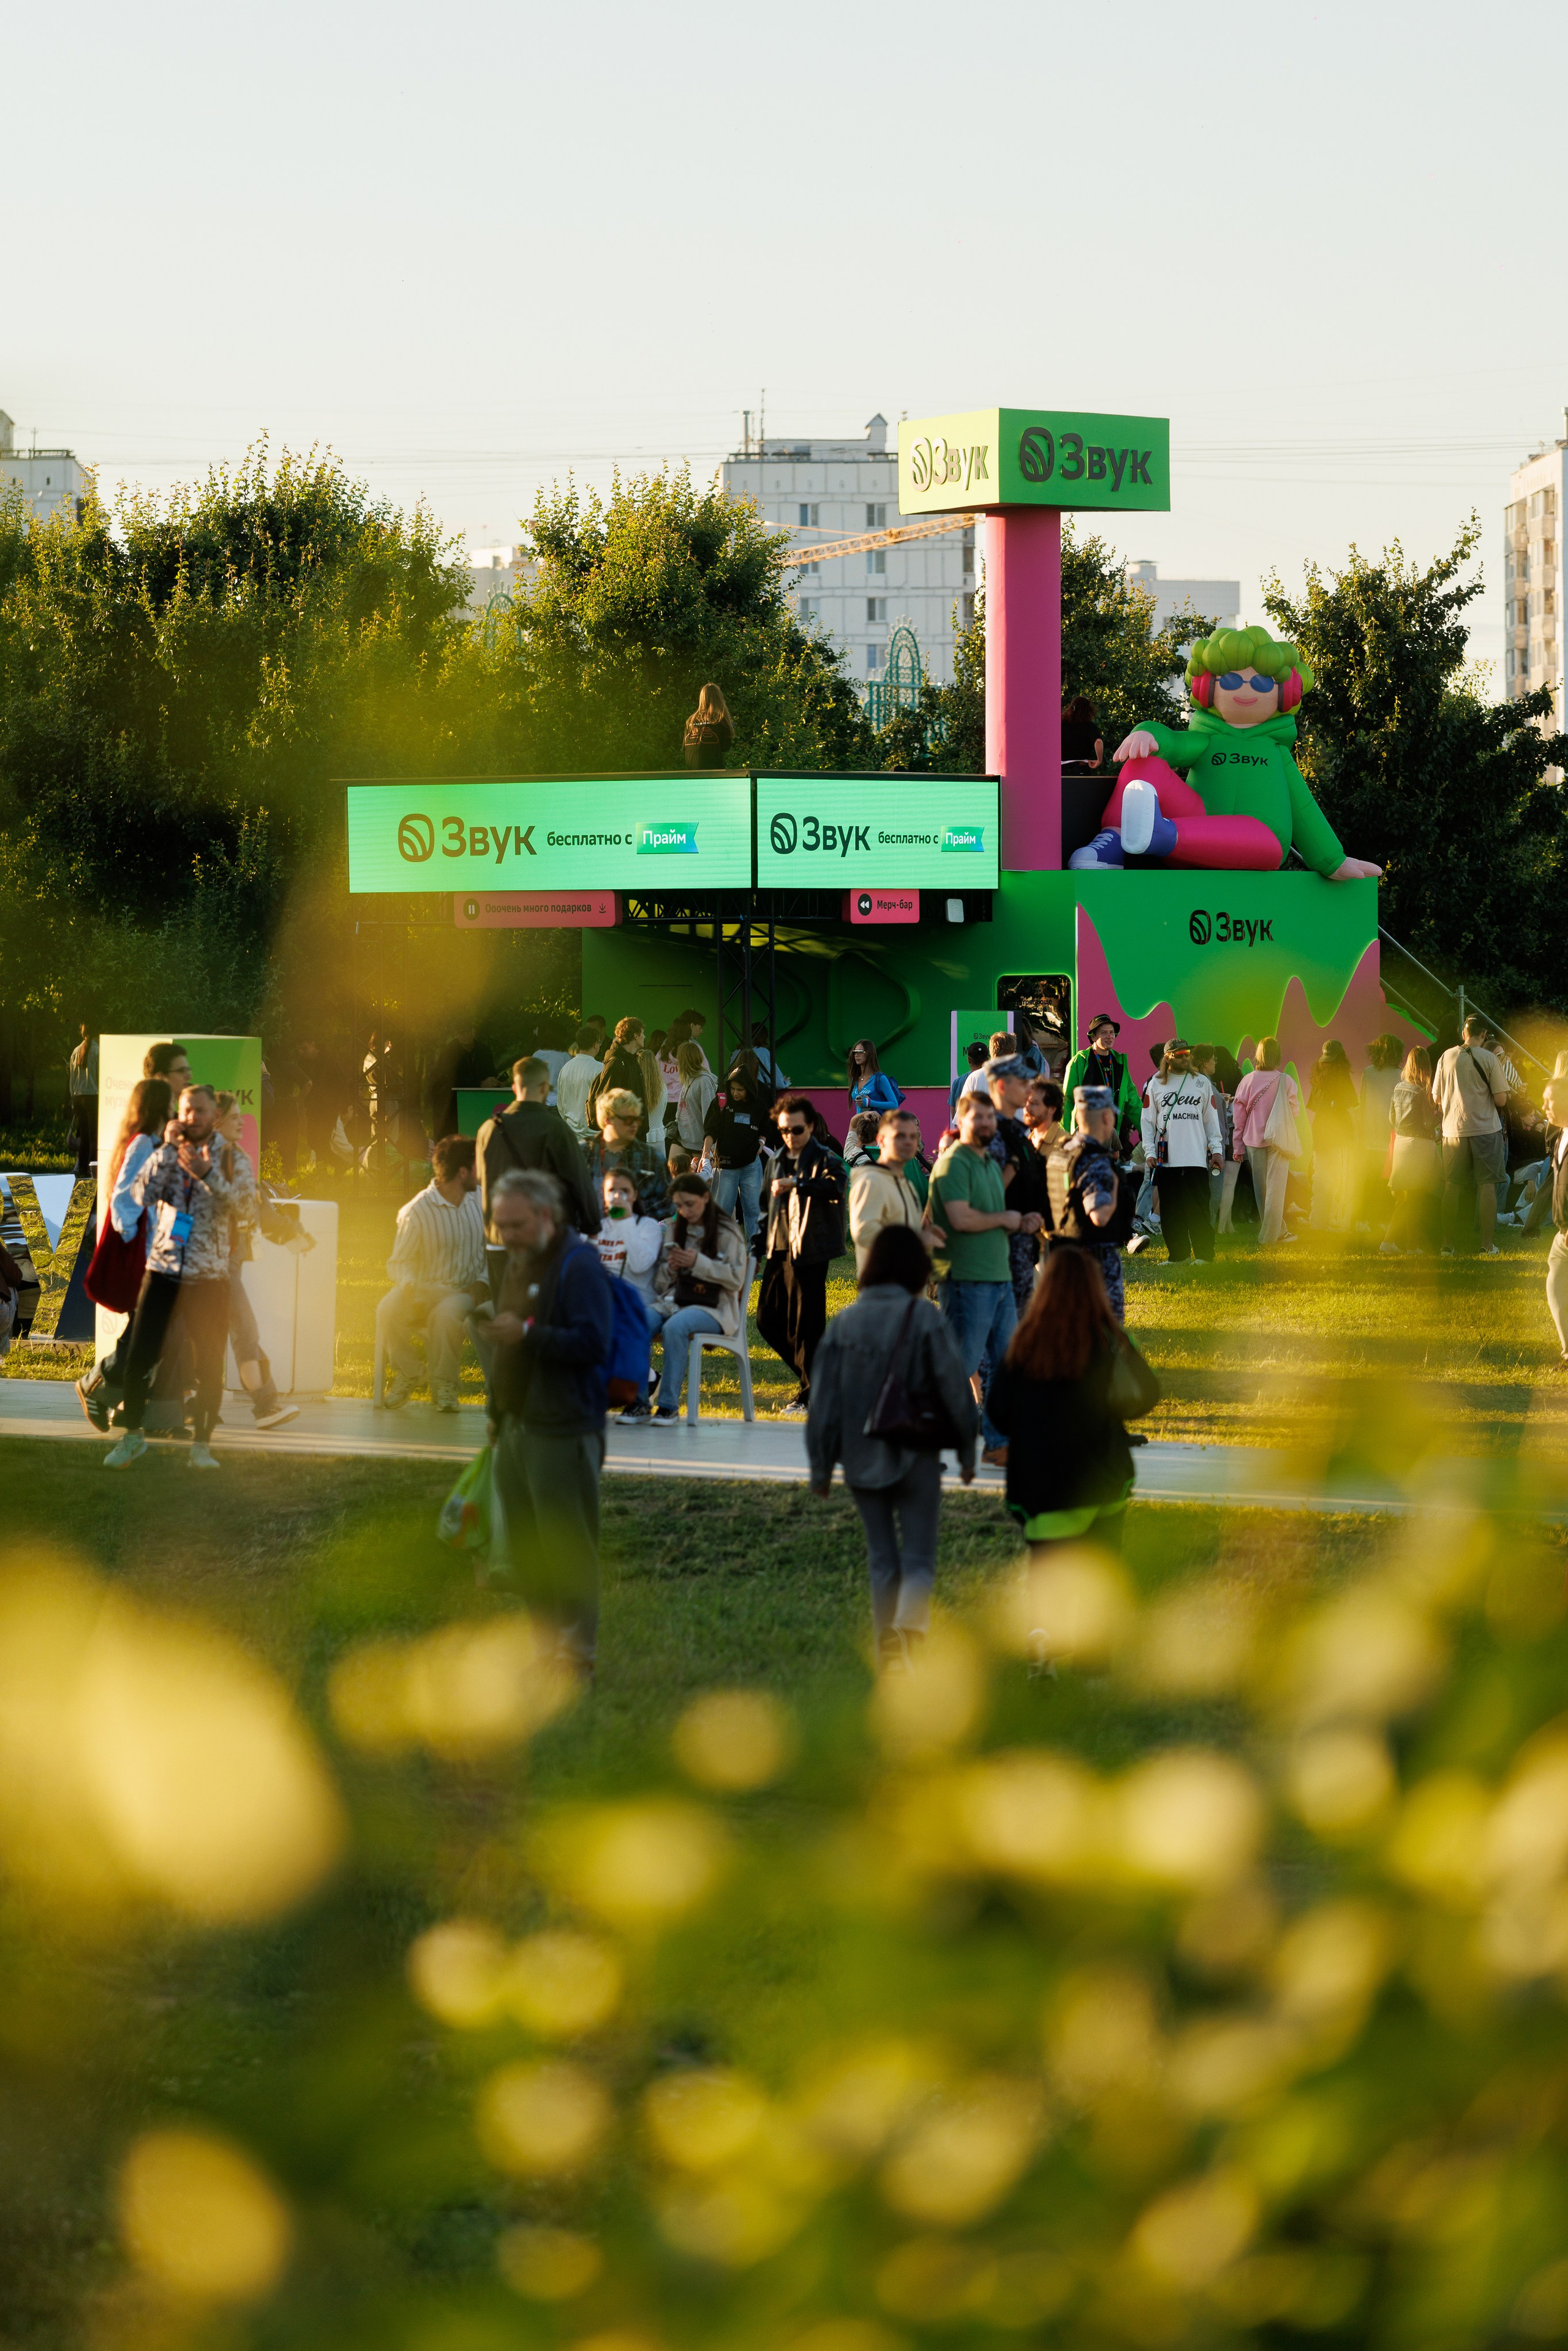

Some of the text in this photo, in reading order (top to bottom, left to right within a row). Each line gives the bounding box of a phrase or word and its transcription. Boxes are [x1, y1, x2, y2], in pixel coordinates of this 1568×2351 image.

[932, 437, 989, 491] Звук
[1060, 432, 1153, 492] Звук
[1229, 753, 1268, 766] Звук
[442, 816, 686, 864] Звук бесплатно с Прайм
[802, 816, 976, 857] Звук бесплатно с Прайм
[485, 903, 591, 914] Ооочень много подарков
[877, 899, 913, 911] Мерч-бар
[1216, 911, 1273, 947] Звук
[1015, 998, 1052, 1007] отрясающе
[1161, 1092, 1201, 1107] Deus
